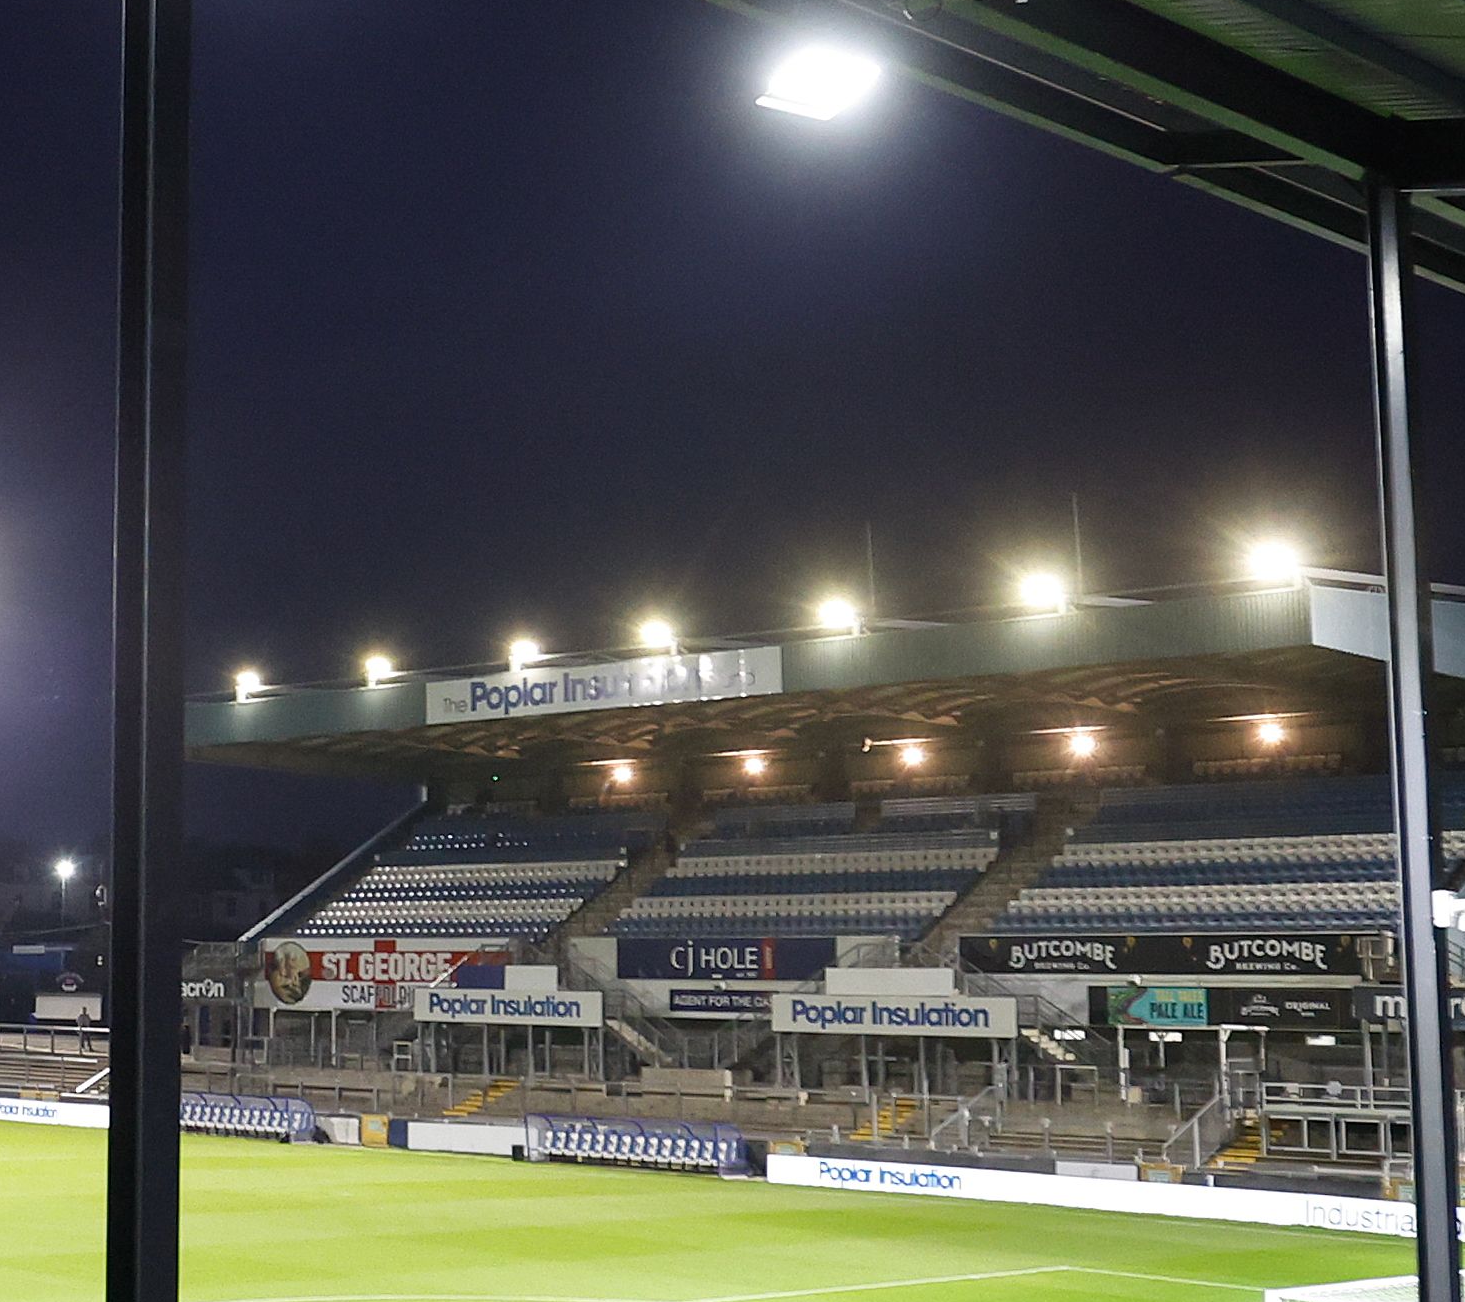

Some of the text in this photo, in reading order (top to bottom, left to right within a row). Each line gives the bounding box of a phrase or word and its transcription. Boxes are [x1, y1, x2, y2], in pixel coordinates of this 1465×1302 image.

[443, 697, 467, 713] The
[471, 676, 557, 715] Poplar
[322, 952, 452, 981] ST. GEORGE
[700, 947, 759, 969] HOLE
[1008, 940, 1117, 969] BUTCOMBE
[1206, 940, 1328, 970] BUTCOMBE
[180, 979, 225, 998] acron
[429, 993, 580, 1018] Poplar Insulation
[792, 1000, 989, 1029] Poplar Insulation
[21, 1104, 57, 1118] Insulation
[820, 1162, 962, 1189] Poplar Insulation
[1305, 1200, 1417, 1234] Industria
